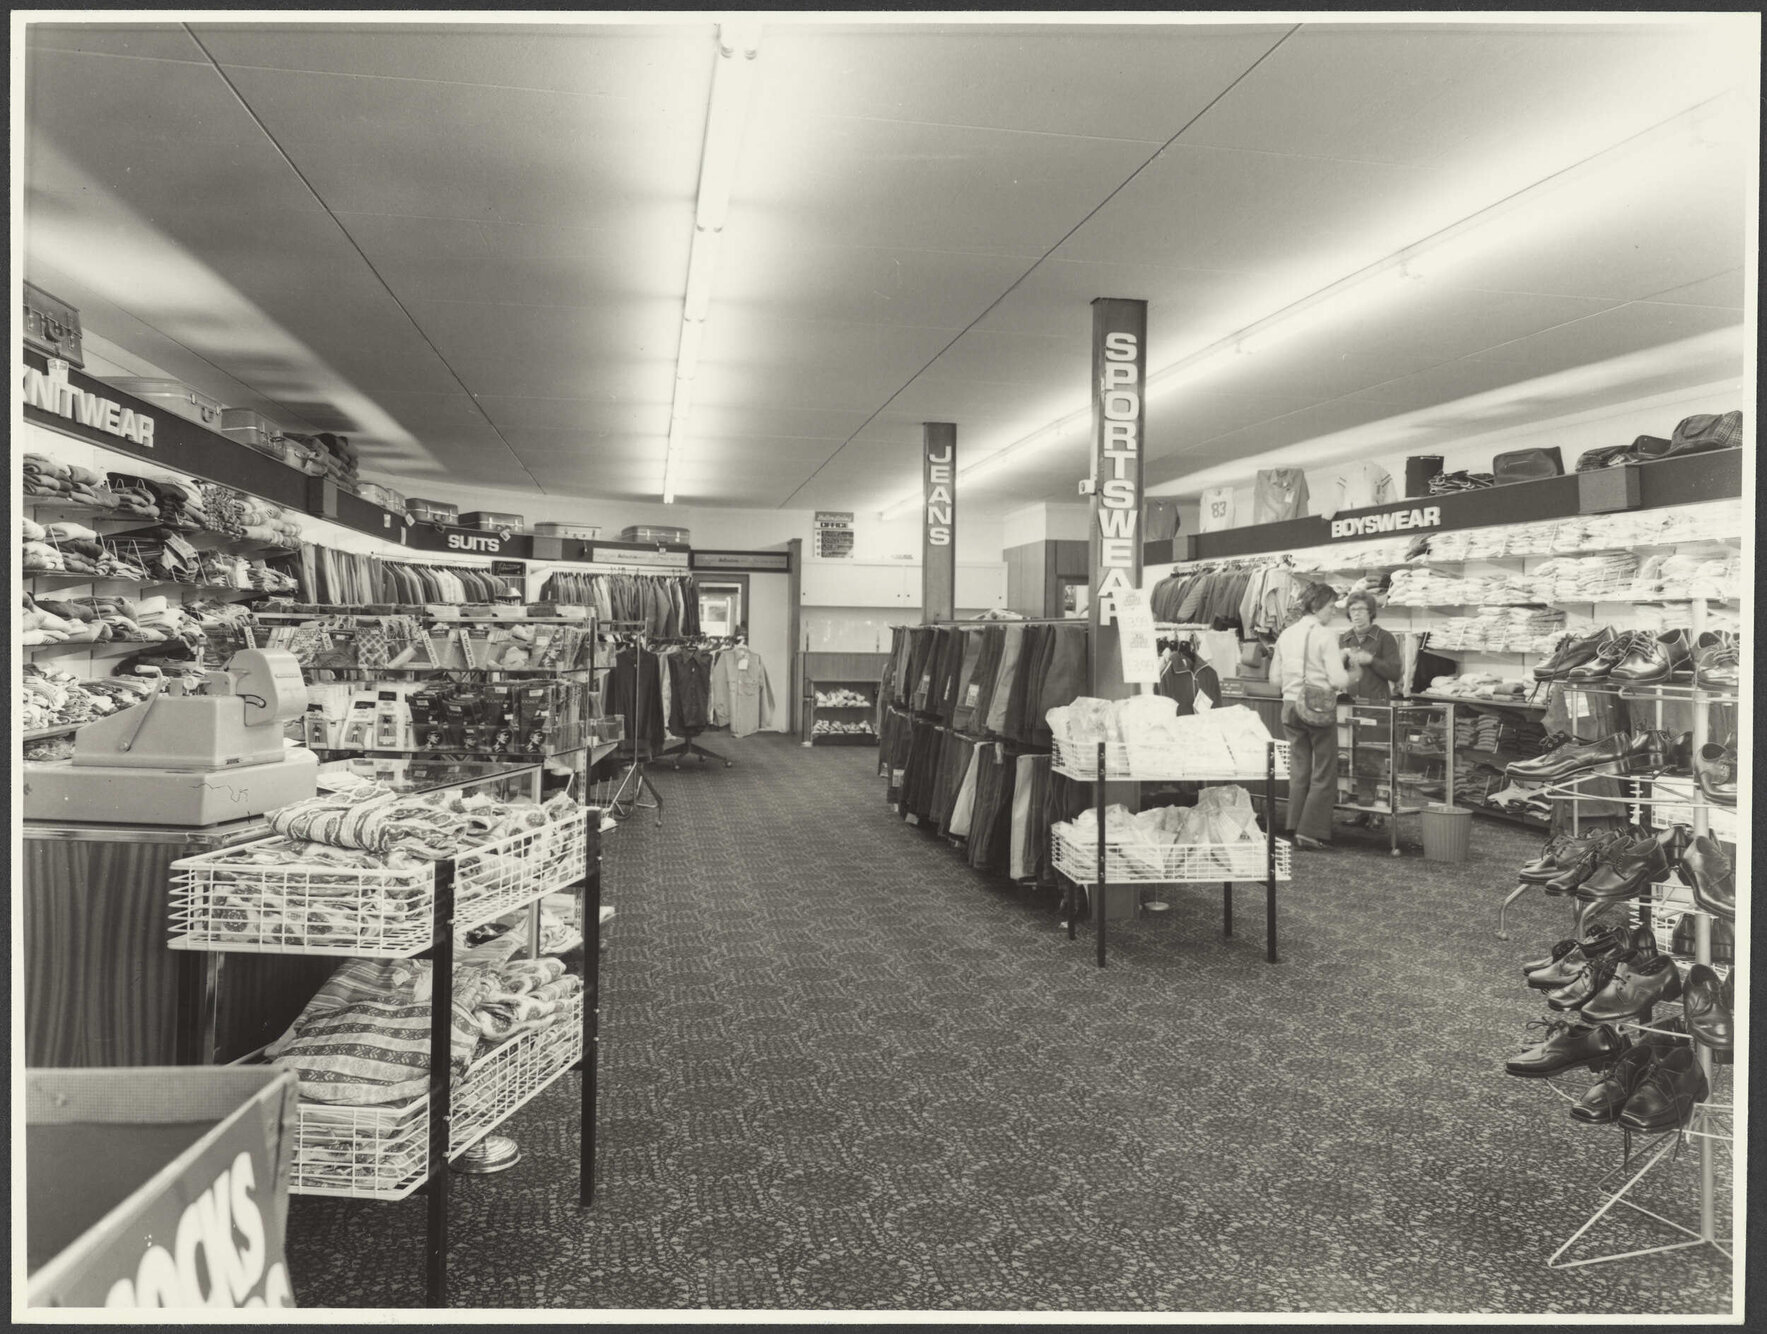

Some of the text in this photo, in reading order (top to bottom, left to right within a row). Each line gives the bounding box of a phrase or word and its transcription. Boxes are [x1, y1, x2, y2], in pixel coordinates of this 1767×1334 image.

[928, 445, 952, 545] JEANS
[1211, 501, 1227, 518] 83
[1331, 506, 1441, 538] BOYSWEAR
[448, 534, 500, 552] SUITS
